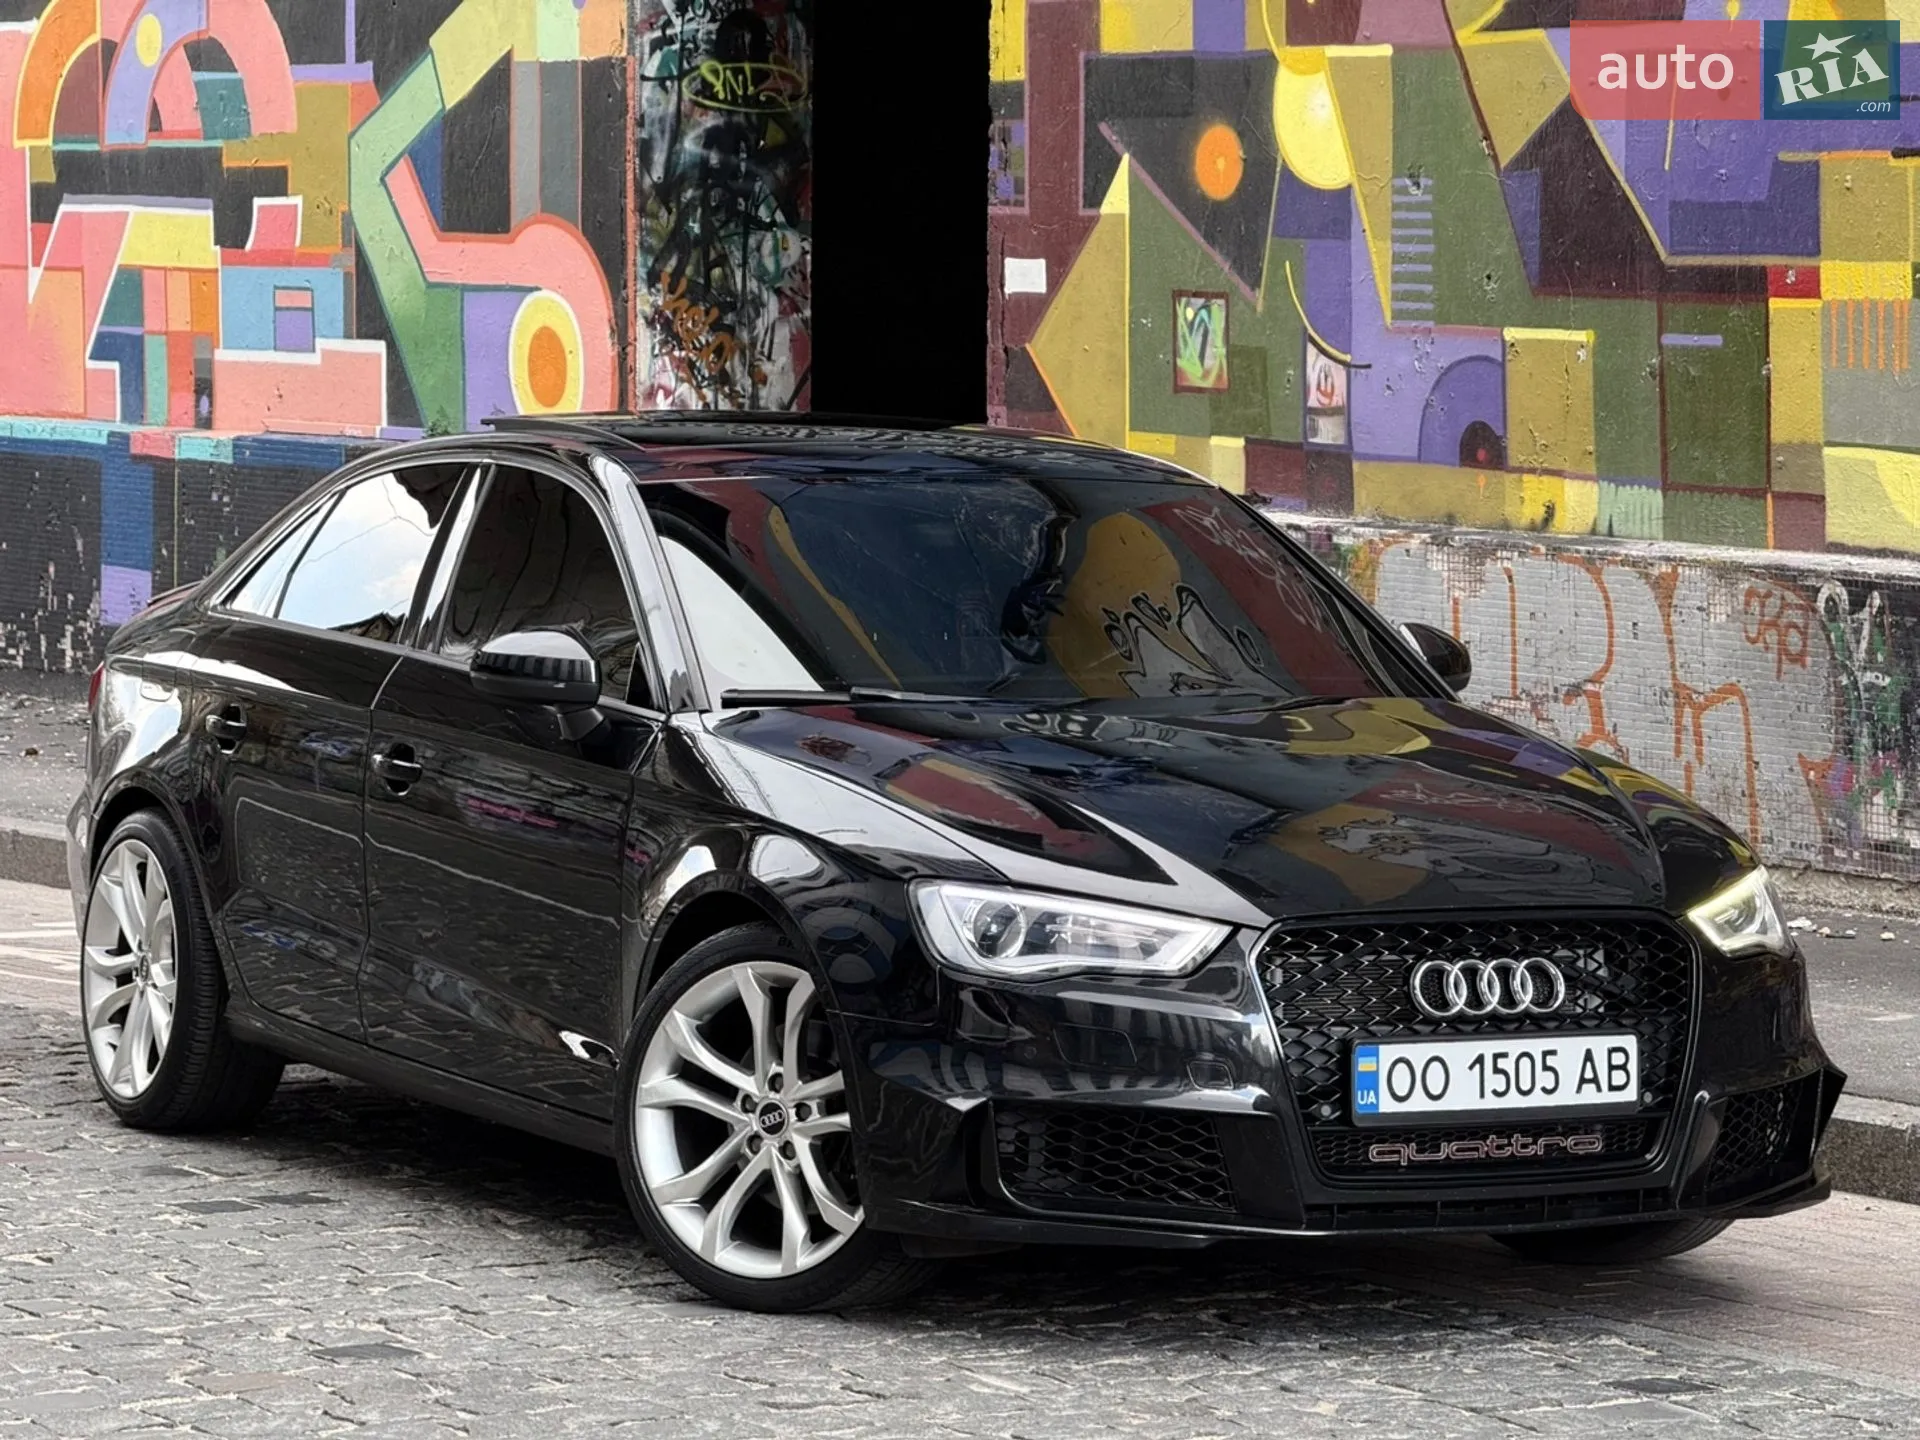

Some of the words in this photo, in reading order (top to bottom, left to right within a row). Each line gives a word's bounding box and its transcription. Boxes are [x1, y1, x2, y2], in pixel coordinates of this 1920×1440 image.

[1386, 1055, 1450, 1103] OO
[1467, 1049, 1560, 1099] 1505
[1575, 1045, 1631, 1095] AB
[1357, 1089, 1377, 1105] UA
[1368, 1133, 1603, 1166] quattro
